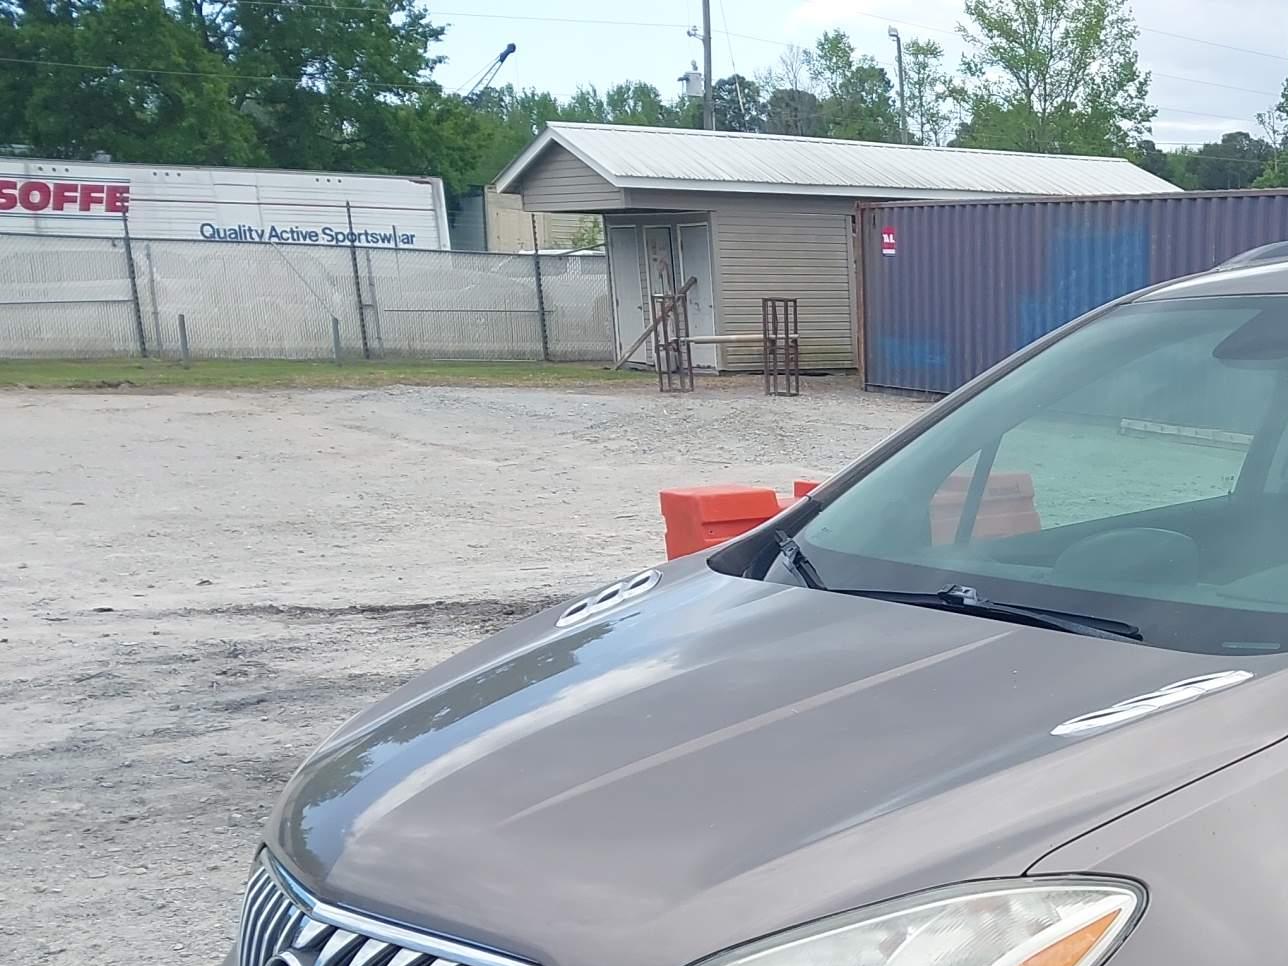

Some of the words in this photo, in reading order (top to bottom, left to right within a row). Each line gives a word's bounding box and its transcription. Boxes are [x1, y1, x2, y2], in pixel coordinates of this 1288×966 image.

[0, 180, 130, 213] SOFFE
[200, 223, 265, 241] Quality
[268, 225, 319, 242] Active
